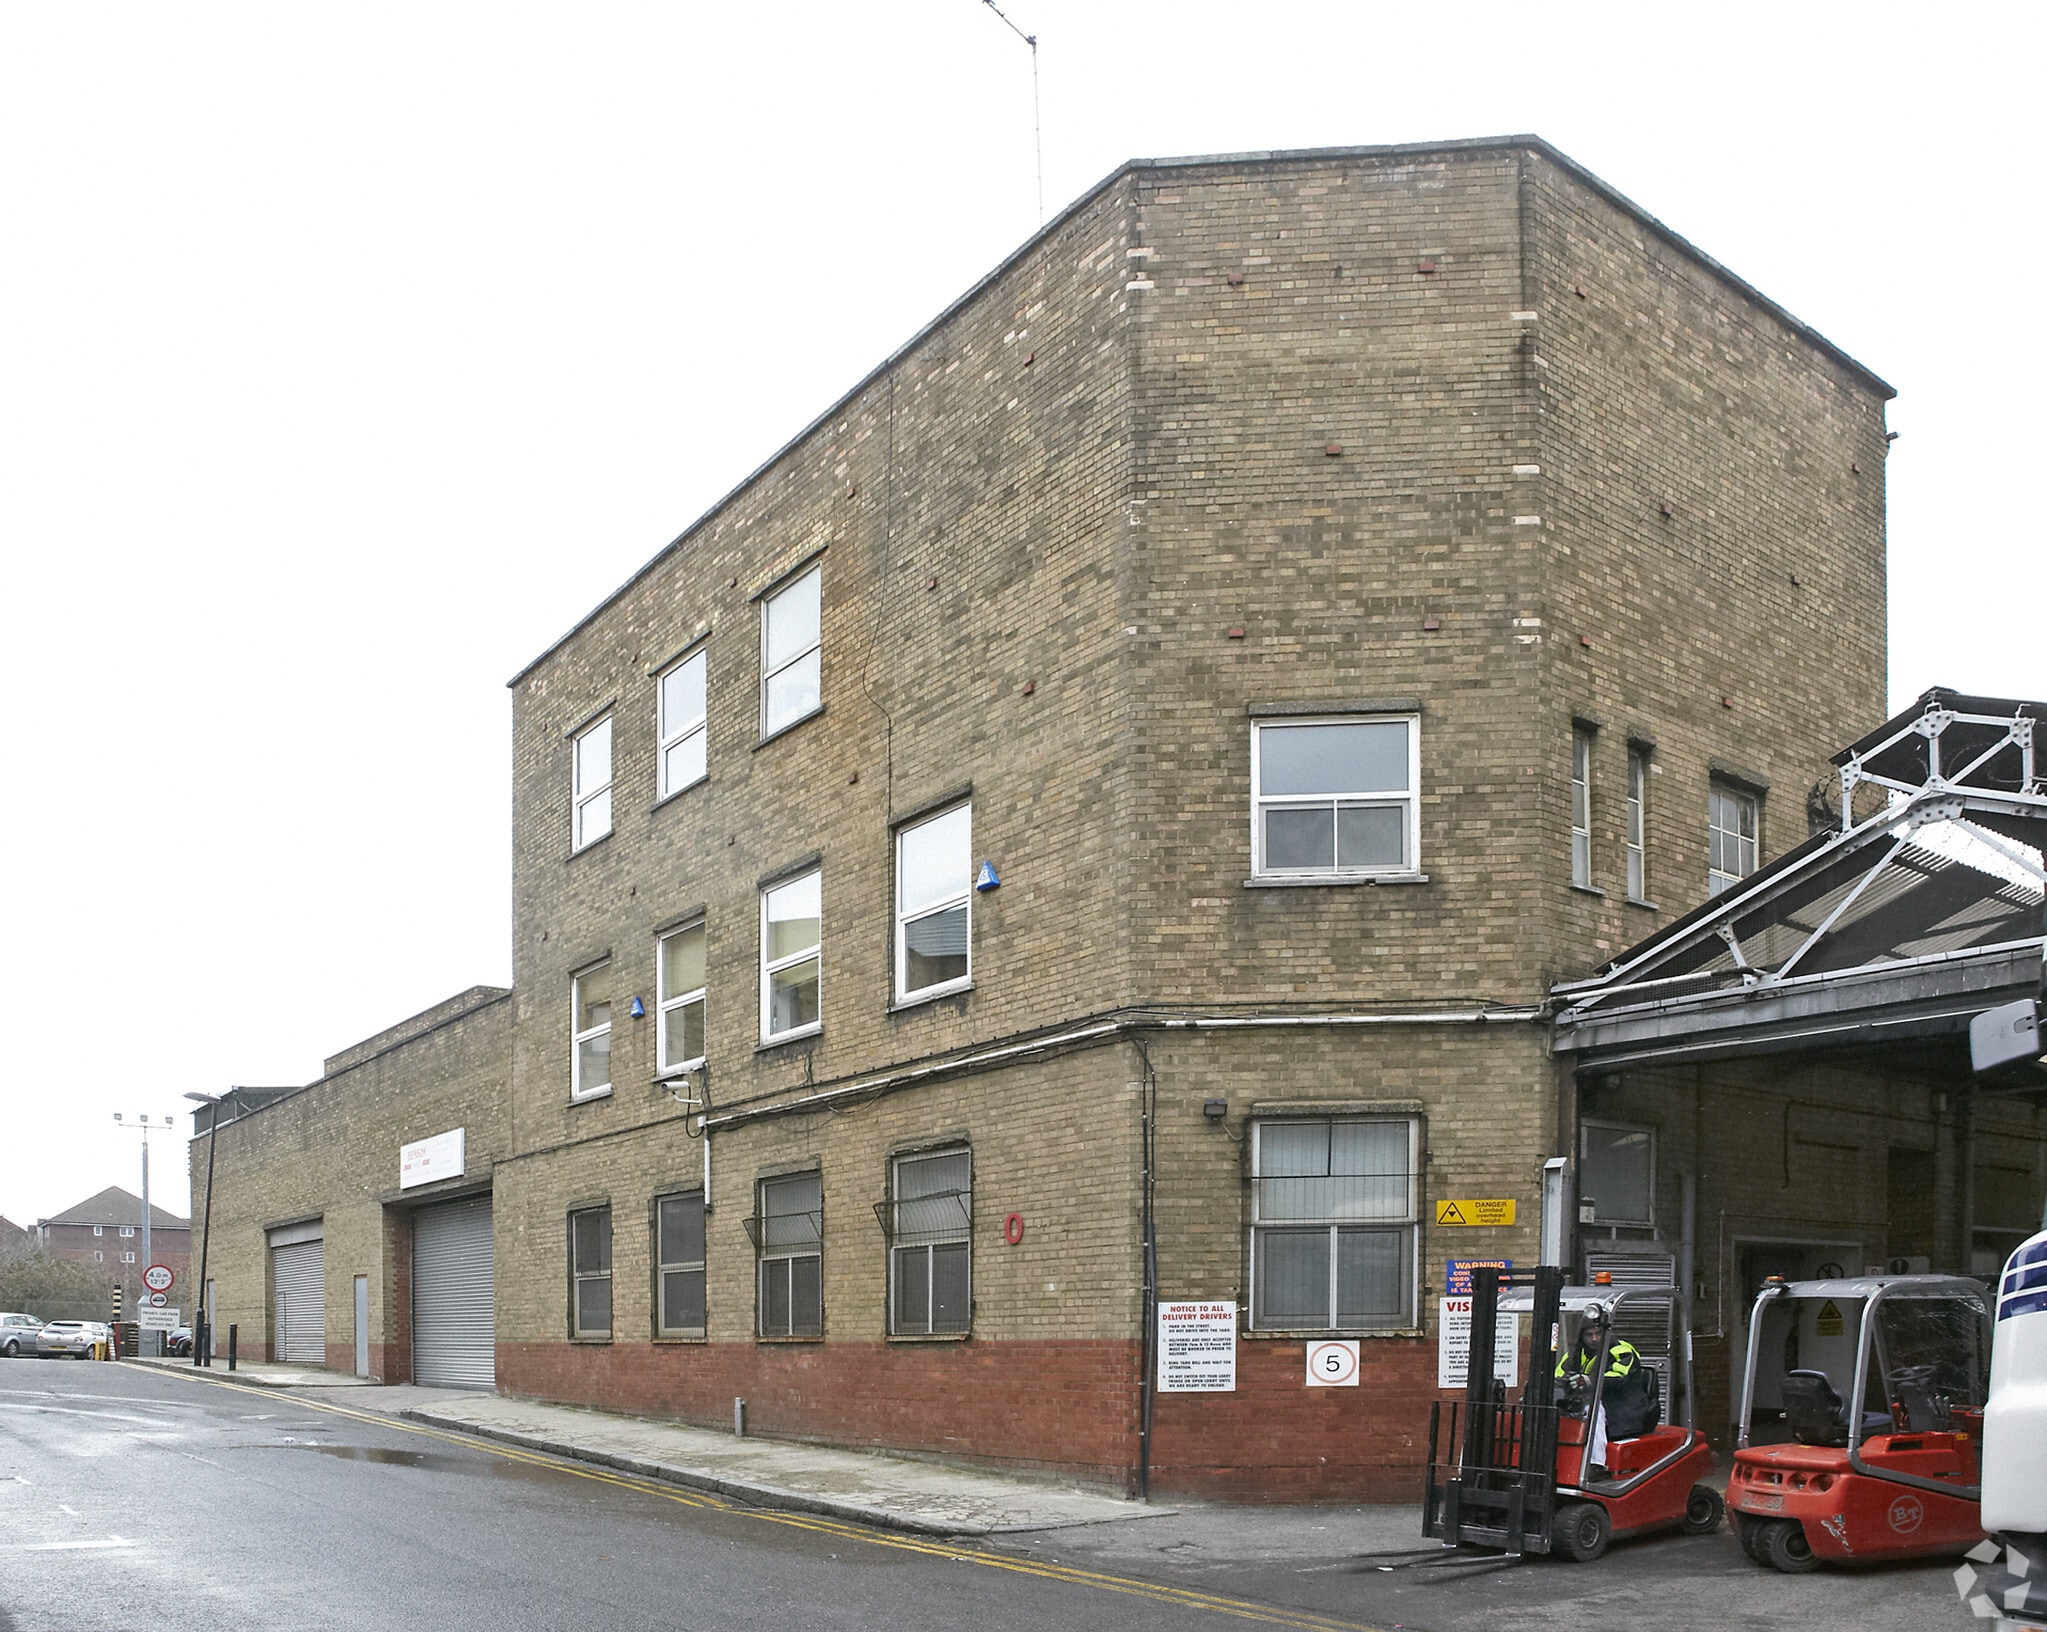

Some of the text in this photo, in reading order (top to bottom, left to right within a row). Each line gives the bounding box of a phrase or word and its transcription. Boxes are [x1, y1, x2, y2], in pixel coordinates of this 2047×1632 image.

[1454, 1261, 1506, 1269] WARNING
[1326, 1355, 1340, 1372] 5
[1893, 1507, 1921, 1521] BT
